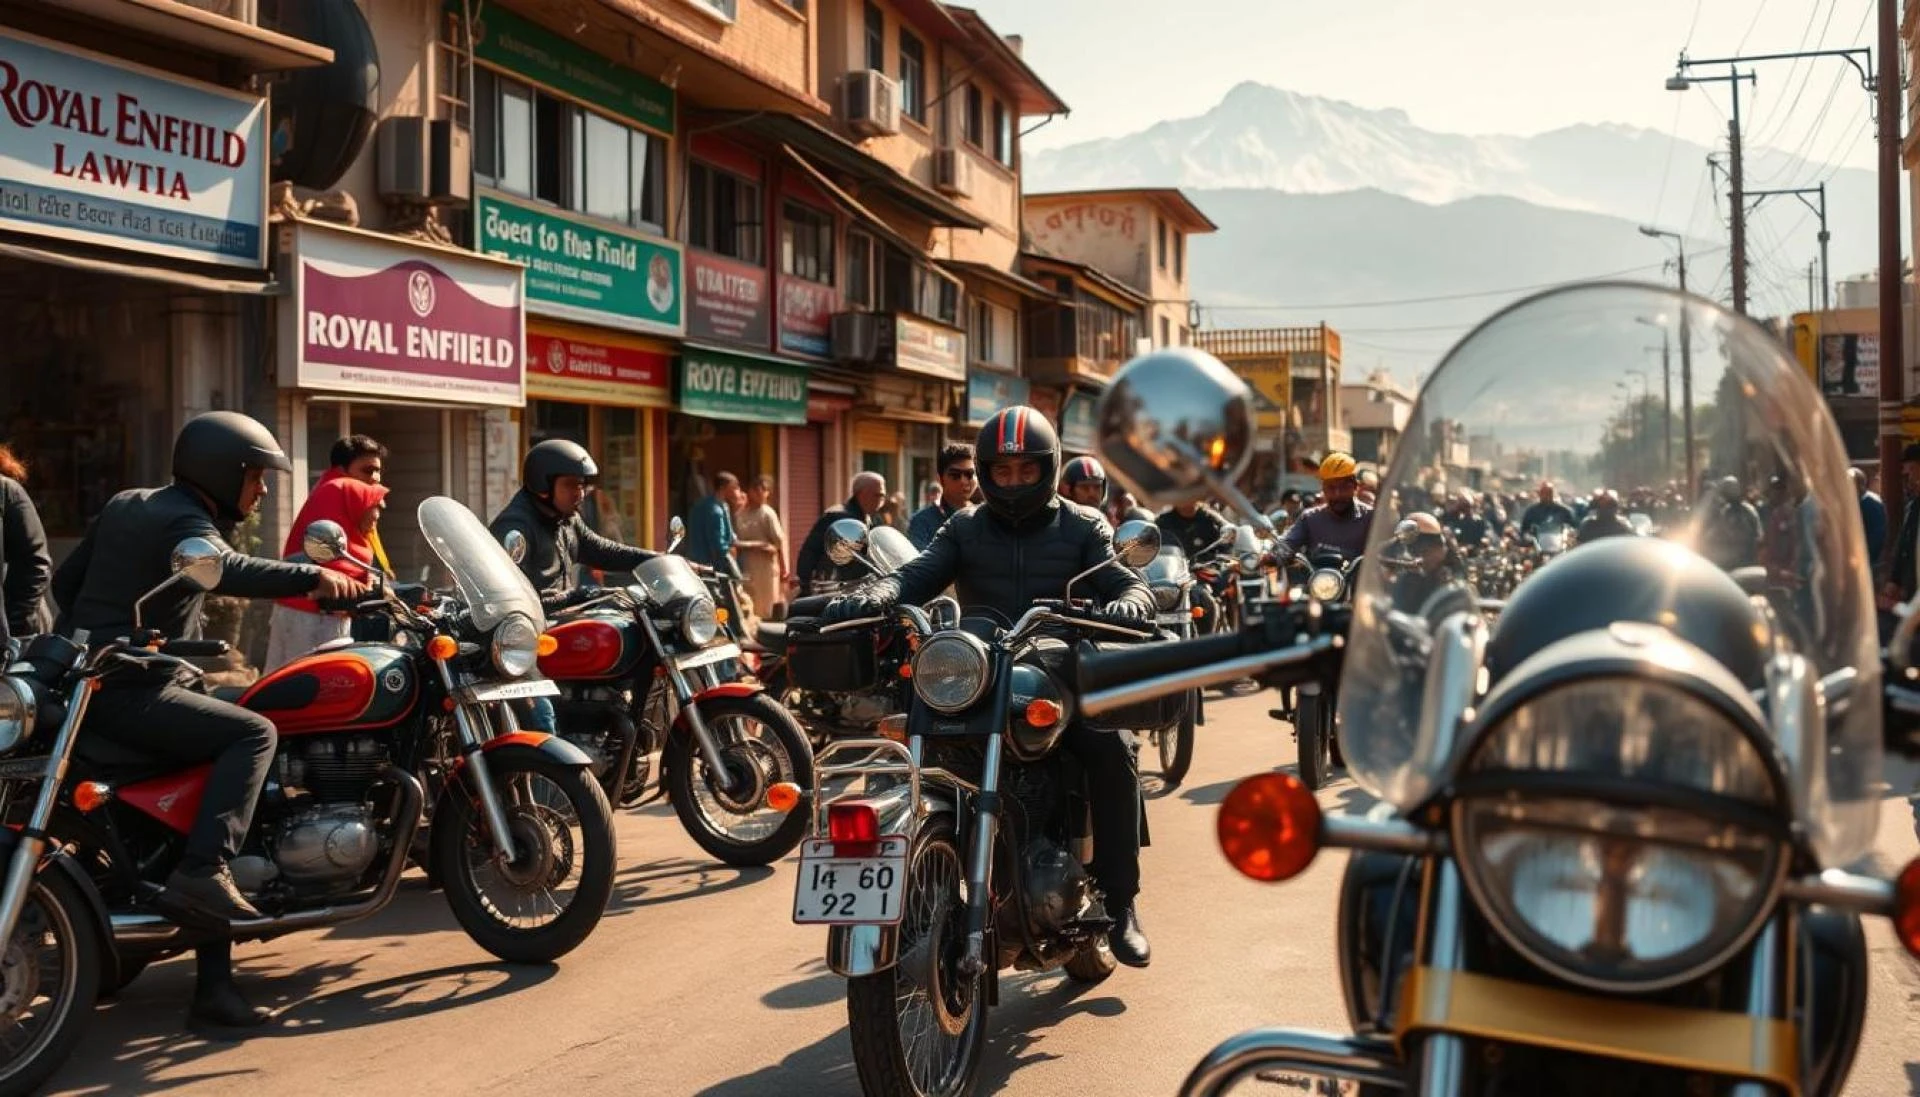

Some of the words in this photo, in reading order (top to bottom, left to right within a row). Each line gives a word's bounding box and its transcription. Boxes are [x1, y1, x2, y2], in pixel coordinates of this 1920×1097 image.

[0, 61, 110, 137] ROYAL
[53, 142, 191, 201] LAWTIA
[538, 223, 558, 253] to
[308, 311, 399, 355] ROYAL
[859, 866, 894, 891] 60
[822, 893, 857, 916] 92
